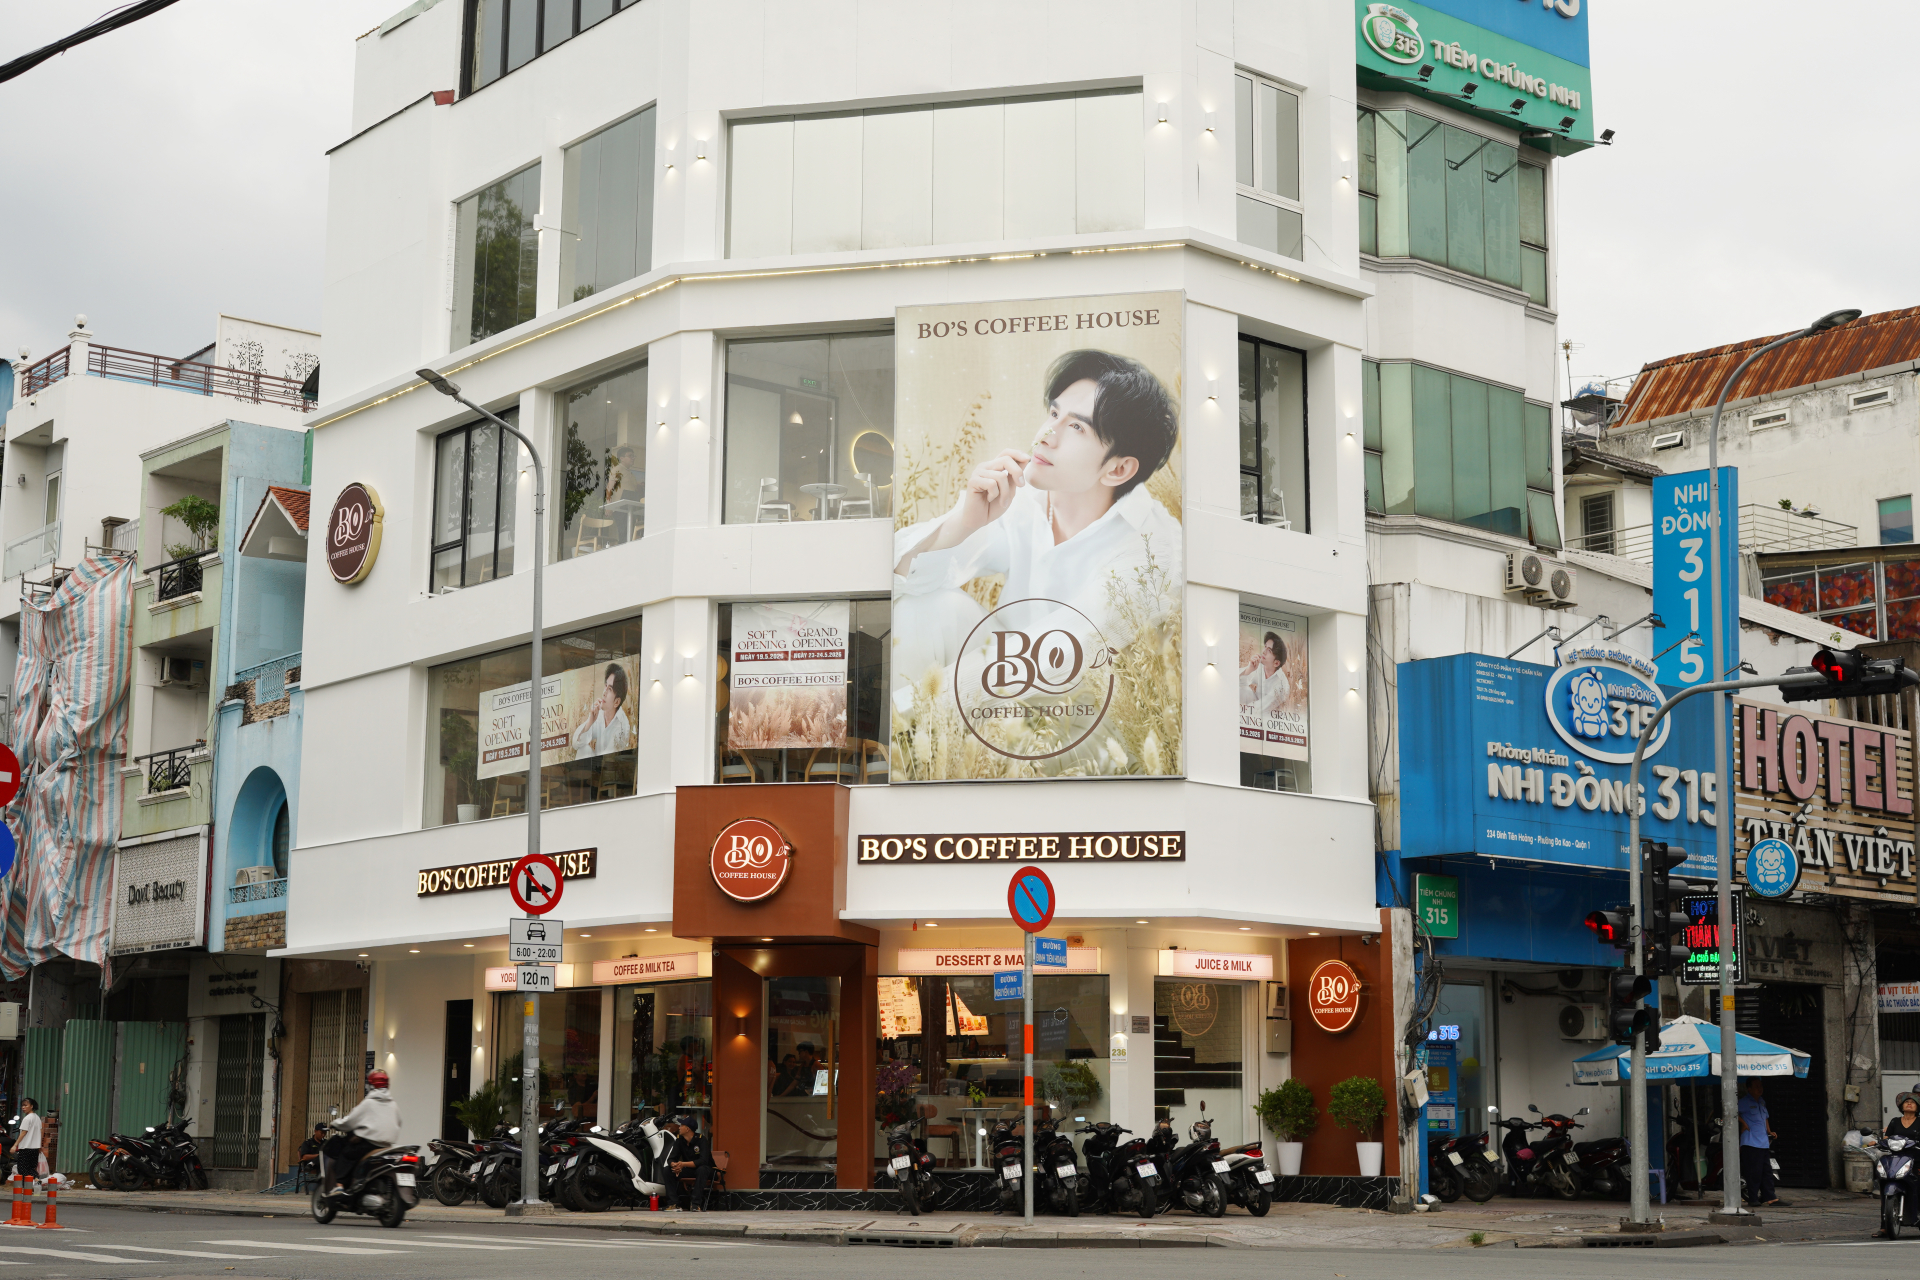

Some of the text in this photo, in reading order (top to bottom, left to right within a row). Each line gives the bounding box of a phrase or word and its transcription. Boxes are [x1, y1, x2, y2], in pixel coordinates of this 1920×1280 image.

[1393, 34, 1419, 57] 315
[1430, 39, 1581, 110] TIÊM CHỦNG NHI
[917, 309, 1160, 340] BO'S COFFEE HOUSE
[1674, 482, 1708, 505] NHI
[330, 543, 366, 560] COFFEE HOUSE
[747, 630, 778, 640] SOFT
[797, 627, 838, 638] GRAND
[738, 639, 787, 650] OPENING
[792, 637, 844, 648] OPENING
[981, 629, 1084, 699] BO
[1567, 645, 1655, 677] HỆ THỐNG PHÒNG KHÁM
[738, 674, 841, 686] BO'S COFFEE HOUSE
[511, 690, 532, 703] COFFEE
[541, 685, 555, 697] OUSE
[1608, 682, 1656, 703] NHI ĐỒNG
[541, 703, 564, 720] RAND
[971, 704, 1095, 720] COFFEE HOUSE
[1239, 703, 1255, 715] OFT
[1270, 709, 1301, 722] GRAND
[492, 714, 515, 731] SOFT
[1239, 714, 1263, 728] ENING
[1266, 719, 1305, 734] OPENING
[1608, 700, 1658, 740] 315
[485, 727, 522, 746] OPENING
[1487, 741, 1569, 767] Phòng khám
[1740, 704, 1913, 815] HOTEL
[1487, 760, 1718, 827] NHI ĐỒNG 315
[861, 834, 1183, 861] BO'S COFFEE HOUSE
[1562, 838, 1571, 847] Kao
[724, 835, 773, 870] BO
[1838, 825, 1915, 887] VIỆT
[551, 851, 591, 878] USE
[417, 868, 452, 895] BO'S
[718, 871, 777, 880] COFFEE HOUSE
[151, 878, 186, 902] Beauty
[1419, 888, 1434, 897] TIÊM
[1753, 882, 1763, 894] NHI
[1778, 880, 1790, 893] 315
[1425, 907, 1449, 925] 315
[1690, 900, 1718, 916] HOT
[1684, 915, 1712, 948] TUẤN
[516, 947, 530, 957] 6:00
[537, 948, 556, 958] 22:00
[935, 954, 992, 967] DESSERT
[993, 954, 1002, 966] &
[613, 960, 675, 976] COFFEE & MILK TEA
[1195, 958, 1253, 972] JUICE & MILK
[522, 972, 550, 986] 120 m
[1317, 975, 1349, 1006] BO
[1334, 1006, 1353, 1014] HOUSE
[1439, 1024, 1460, 1041] 315
[1111, 1048, 1127, 1057] 236
[1645, 1062, 1701, 1074] NHI ĐỒNG 315
[1750, 1061, 1774, 1071] ĐỒNG
[1775, 1063, 1788, 1071] 315
